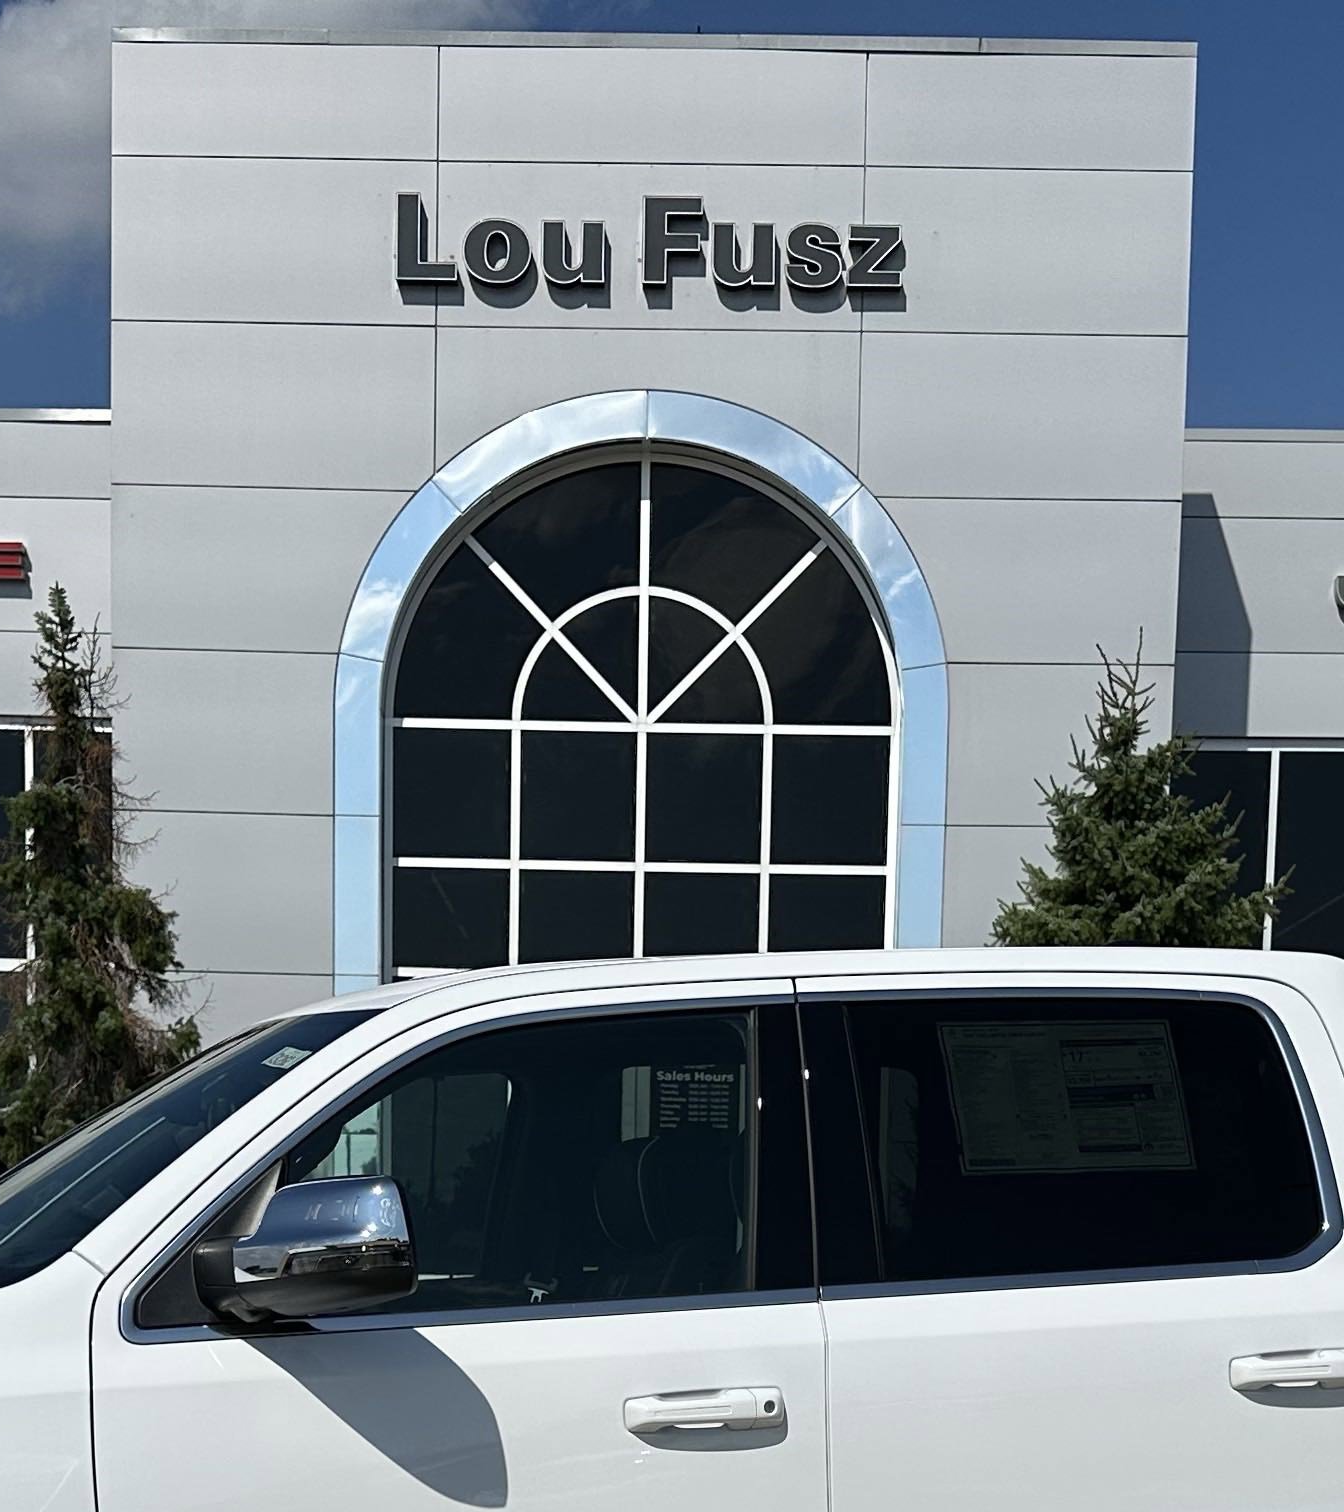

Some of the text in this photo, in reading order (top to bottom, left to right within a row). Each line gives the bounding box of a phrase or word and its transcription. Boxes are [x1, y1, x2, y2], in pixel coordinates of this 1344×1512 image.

[395, 191, 904, 289] Lou Fusz
[656, 1070, 734, 1082] Sales Hours
